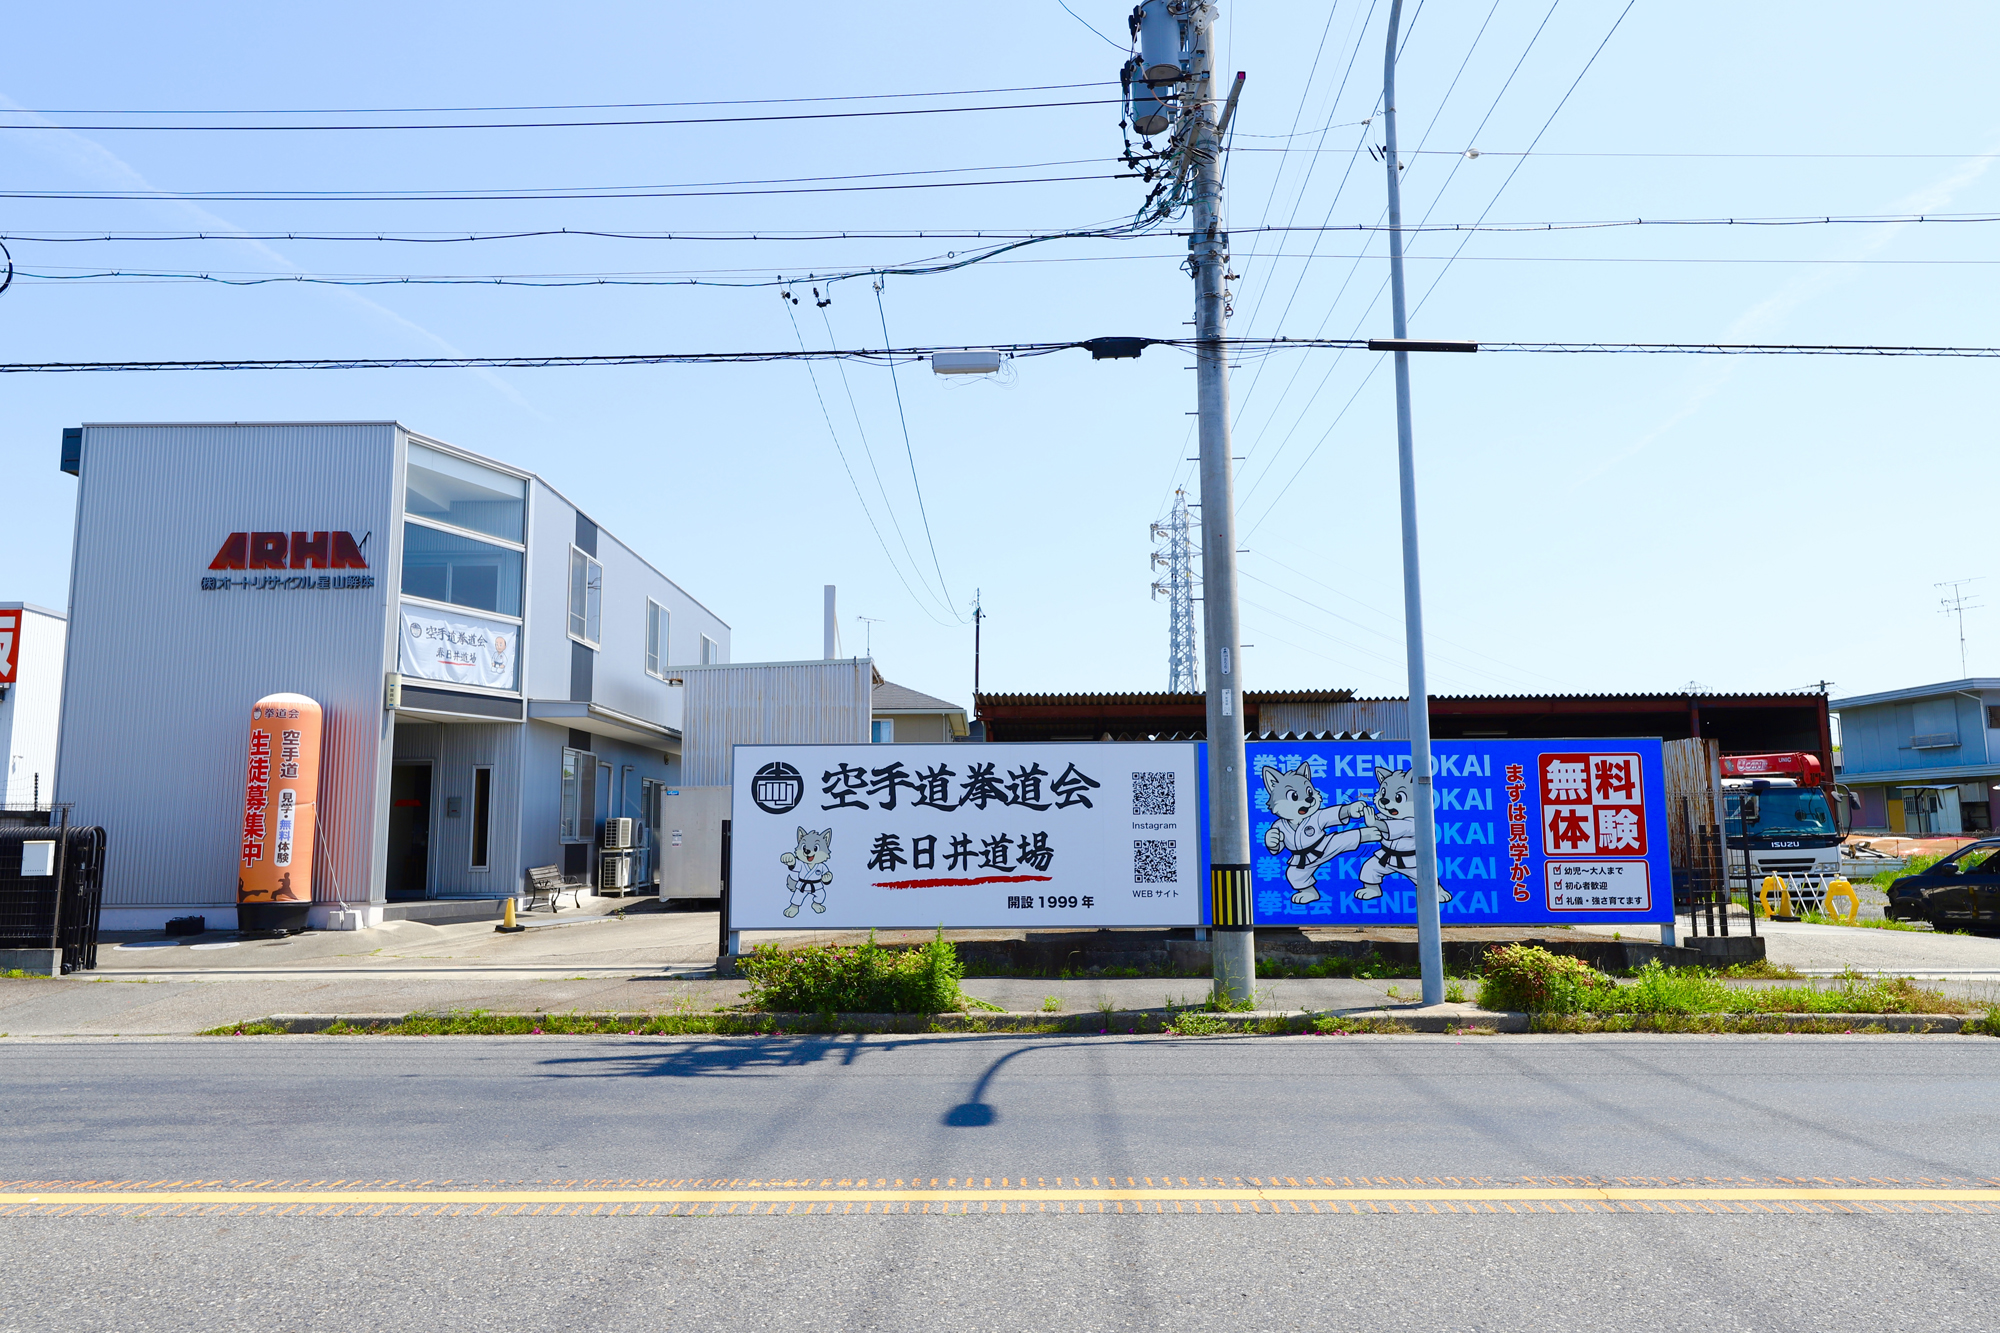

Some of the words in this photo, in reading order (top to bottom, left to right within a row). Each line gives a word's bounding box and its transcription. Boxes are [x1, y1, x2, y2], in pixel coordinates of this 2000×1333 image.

[425, 625, 488, 648] 空手道拳道会
[436, 647, 477, 663] 春日井道場
[264, 708, 300, 719] 拳道会
[280, 729, 301, 779] 空手道
[242, 729, 271, 868] 生徒募集中
[821, 762, 1101, 812] 空手道拳道会
[1132, 822, 1177, 831] Instagram
[1505, 763, 1531, 902] まずは見学から
[867, 831, 1055, 872] 春日井道場
[1132, 890, 1153, 898] WEB
[1565, 881, 1608, 890] 初心者歓迎
